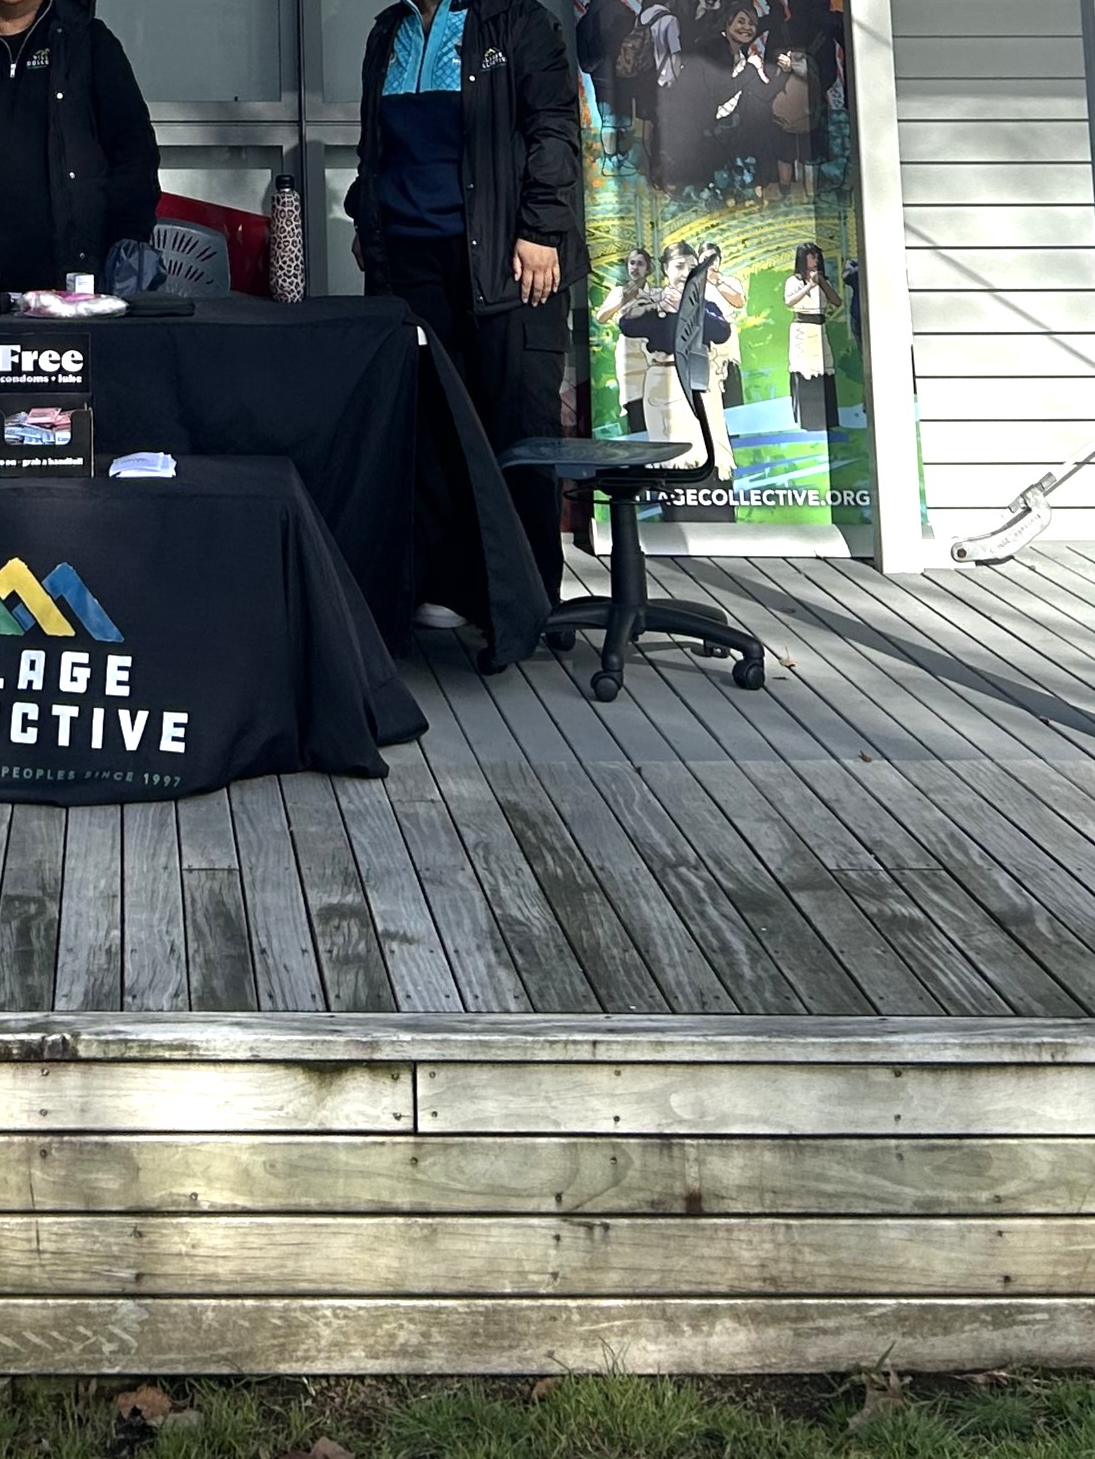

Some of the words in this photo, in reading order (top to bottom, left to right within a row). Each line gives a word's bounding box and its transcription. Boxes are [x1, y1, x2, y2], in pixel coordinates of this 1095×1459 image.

[0, 373, 49, 383] condoms
[57, 373, 83, 383] lube
[1, 765, 76, 780] PEOPLES
[84, 770, 134, 782] SINCE
[143, 772, 182, 788] 1997
